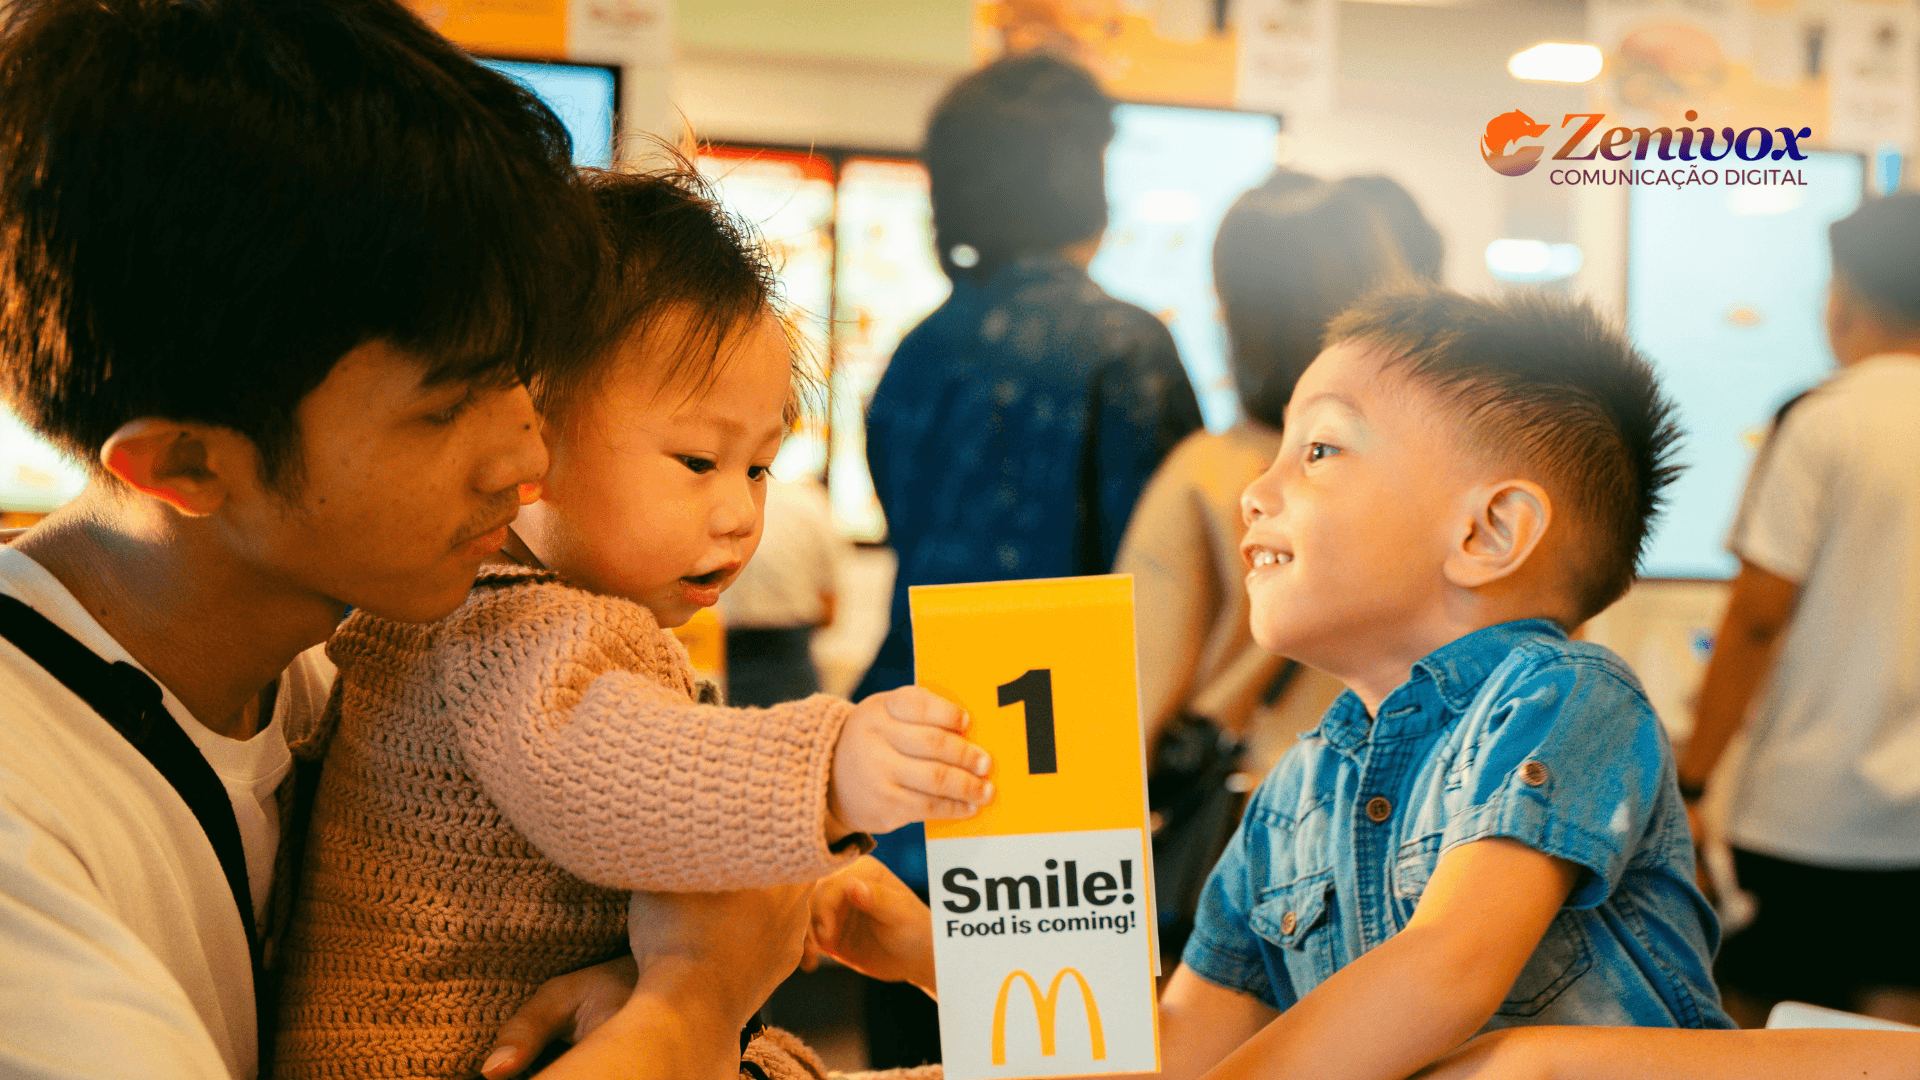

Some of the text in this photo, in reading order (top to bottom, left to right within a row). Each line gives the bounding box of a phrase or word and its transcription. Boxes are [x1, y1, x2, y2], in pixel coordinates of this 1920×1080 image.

[997, 669, 1058, 775] 1
[942, 859, 1135, 913] Smile!
[947, 911, 1136, 937] Food is coming!
